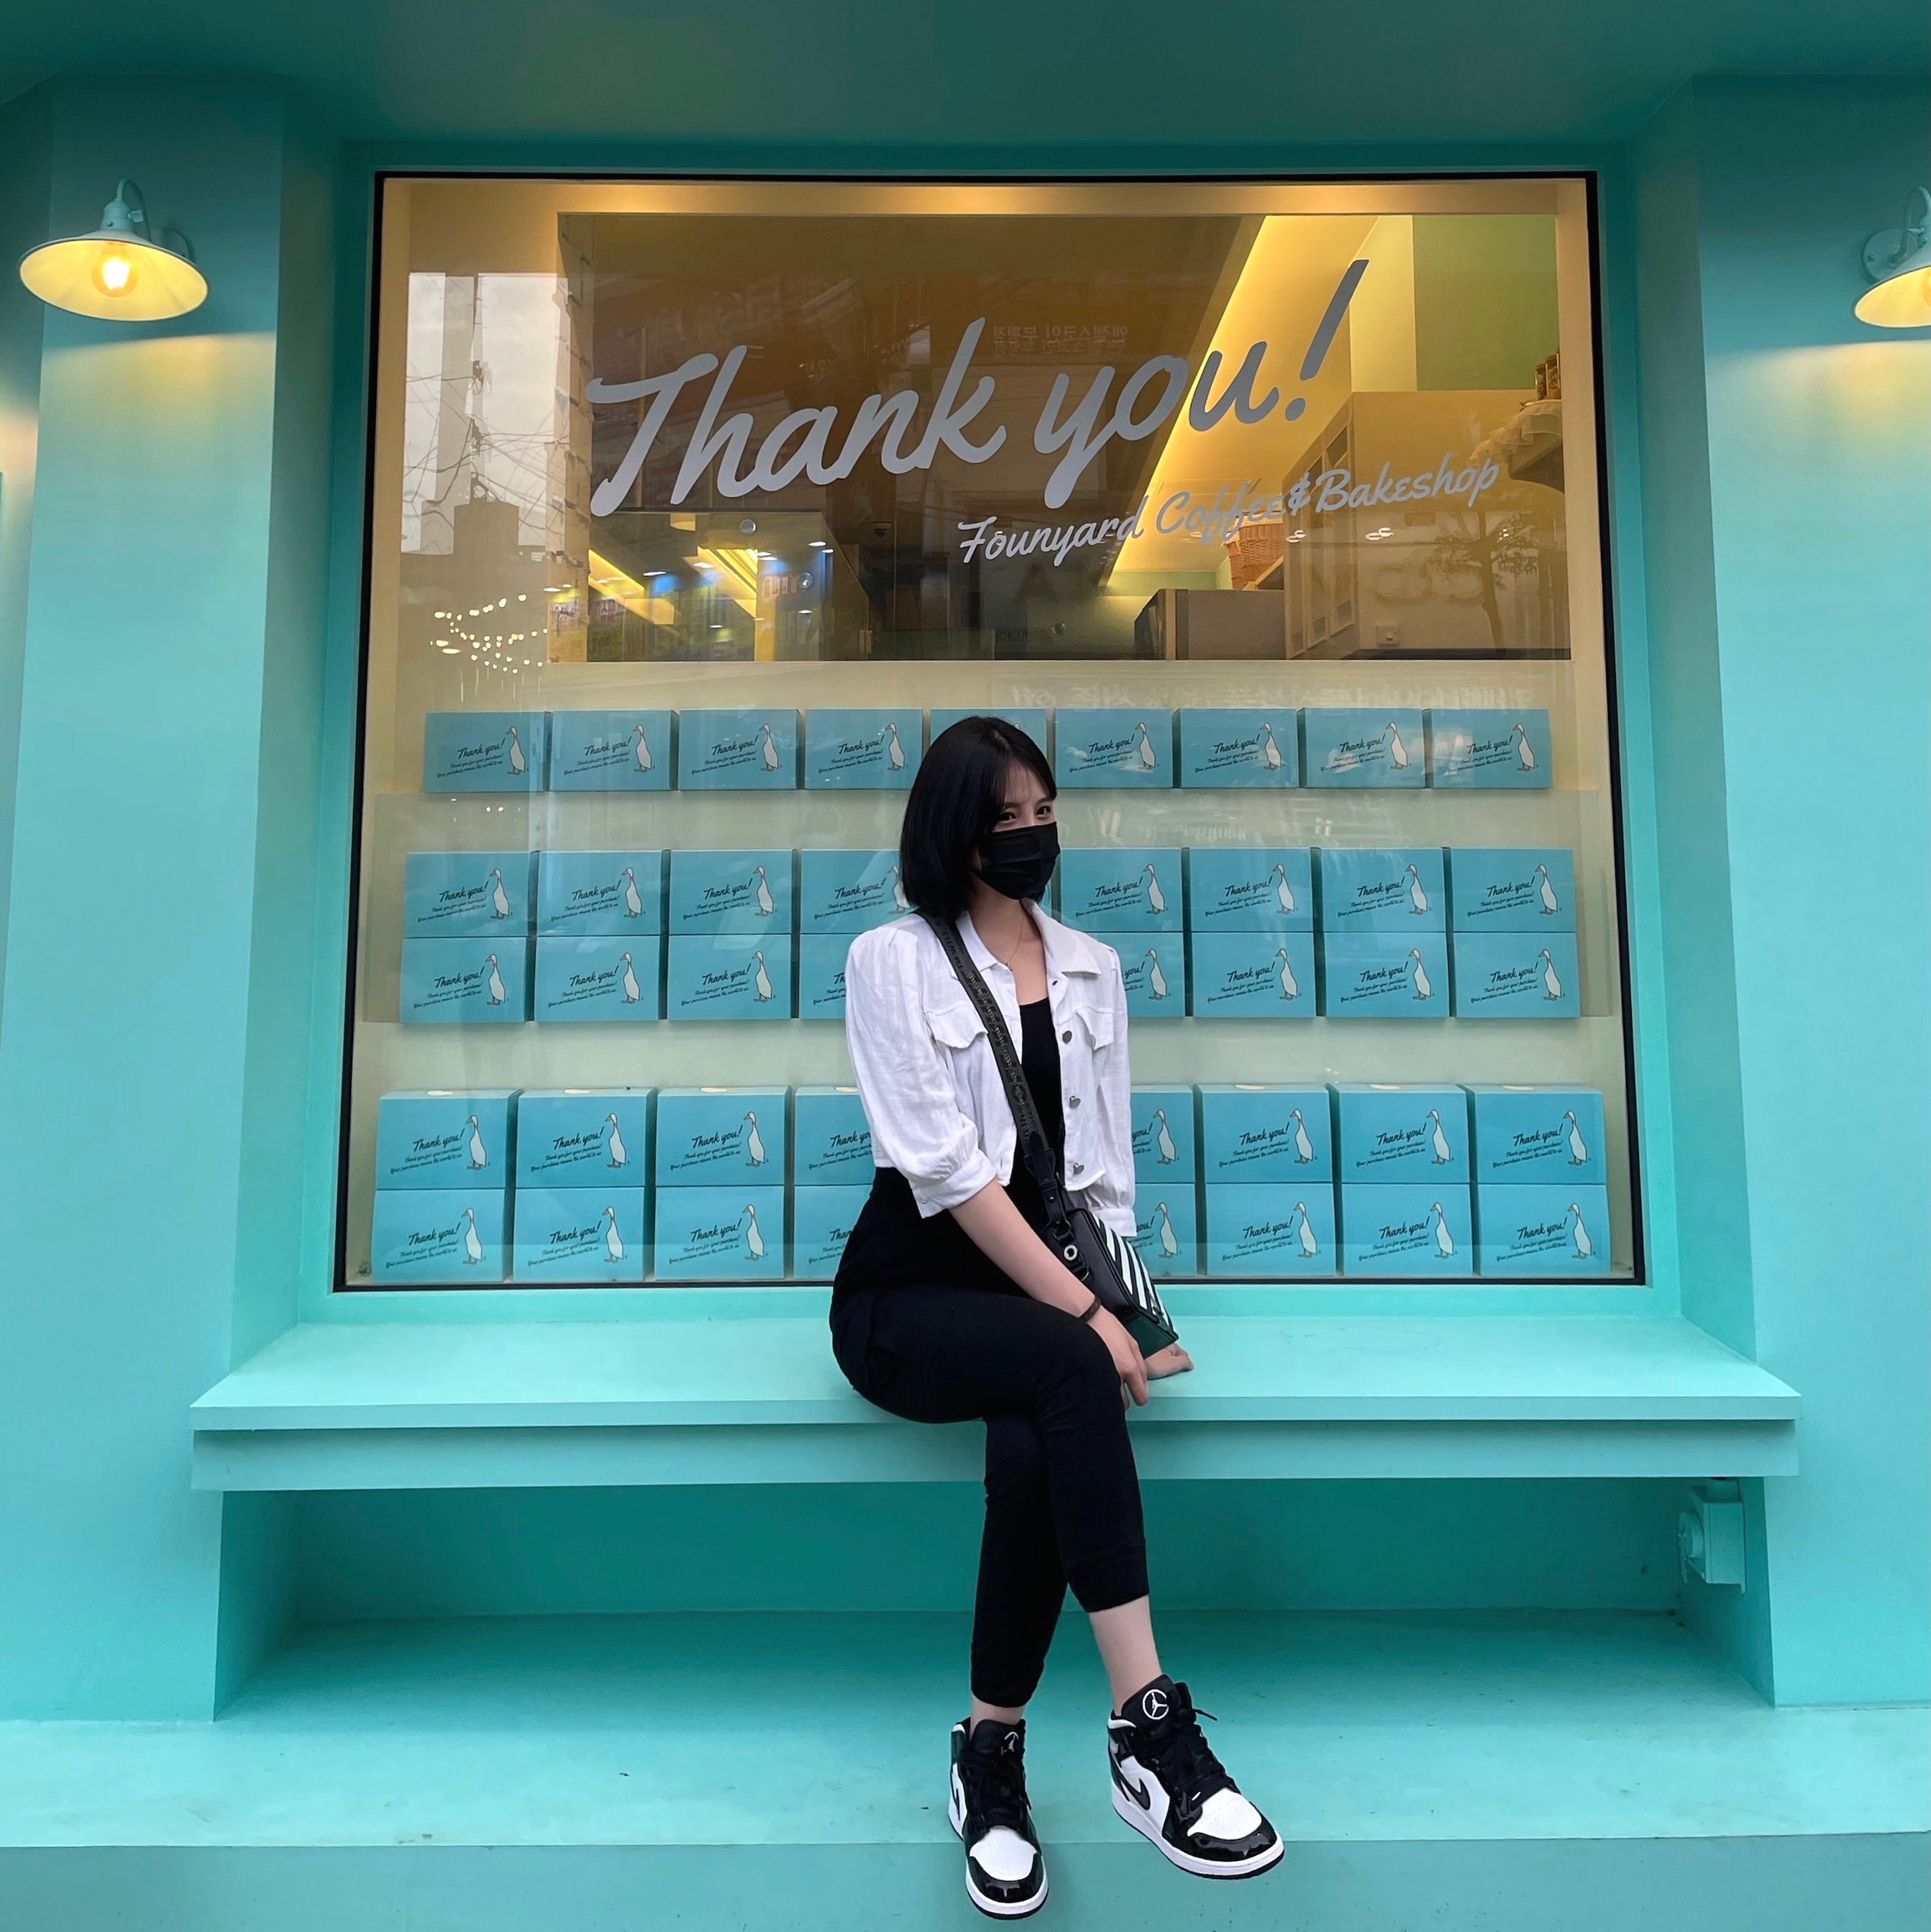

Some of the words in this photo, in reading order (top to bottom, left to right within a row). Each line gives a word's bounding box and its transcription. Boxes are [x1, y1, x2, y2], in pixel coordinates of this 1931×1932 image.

[585, 317, 1006, 516] Thank
[1033, 259, 1369, 509] you!
[957, 494, 1149, 567] Founyard
[457, 744, 483, 759] Thank
[485, 738, 505, 756] you!
[584, 742, 610, 756] Thank
[612, 735, 631, 753] you!
[711, 741, 737, 755] Thank
[739, 734, 758, 752] you!
[838, 740, 863, 755] Thank
[865, 734, 885, 752] you!
[1089, 739, 1114, 754] Thank
[1115, 733, 1135, 751] you!
[1214, 739, 1239, 754] Thank
[1241, 734, 1260, 751] you!
[1339, 739, 1365, 752] Thank
[1366, 733, 1386, 750] you!
[1466, 740, 1492, 755] Thank
[1494, 734, 1513, 752] you!
[439, 887, 466, 902] Thank
[467, 880, 488, 899] you!
[572, 885, 598, 901] Thank
[601, 879, 621, 898] you!
[704, 884, 730, 899] Thank
[732, 878, 752, 896] you!
[834, 884, 862, 899] Thank
[863, 878, 884, 896] you!
[1095, 882, 1121, 897] Thank
[1123, 876, 1143, 894] you!
[1225, 881, 1251, 896] Thank
[1252, 875, 1273, 893] you!
[1357, 882, 1384, 897] Thank
[1385, 876, 1405, 894] you!
[1487, 882, 1513, 897] Thank
[1515, 875, 1535, 894] you!
[434, 972, 462, 988] Thank
[463, 966, 484, 985] you!
[570, 971, 596, 987] Thank
[598, 965, 618, 983] you!
[702, 970, 729, 985] Thank
[730, 963, 751, 982] you!
[1125, 962, 1145, 979] you!
[1227, 967, 1254, 983] Thank
[1255, 961, 1275, 980] you!
[1360, 967, 1387, 982] Thank
[1388, 960, 1409, 980] you!
[1490, 967, 1517, 983] Thank
[1518, 961, 1539, 980] you!
[413, 1135, 441, 1152] Thank
[443, 1128, 465, 1148] you!
[553, 1133, 580, 1149] Thank
[583, 1126, 604, 1147] you!
[692, 1131, 719, 1148] Thank
[721, 1124, 743, 1145] you!
[830, 1131, 858, 1148] Thank
[859, 1131, 872, 1144] yo
[1132, 1122, 1153, 1141] you!
[1239, 1129, 1267, 1145] Thank
[1269, 1122, 1290, 1142] you!
[1377, 1129, 1404, 1145] Thank
[1406, 1122, 1427, 1142] you!
[1513, 1130, 1540, 1146] Thank
[1542, 1123, 1563, 1143] you!
[408, 1229, 437, 1246] Thank
[439, 1221, 460, 1242] you!
[550, 1227, 578, 1244] Thank
[580, 1220, 601, 1241] you!
[690, 1225, 718, 1241] Thank
[720, 1218, 741, 1239] you!
[830, 1229, 852, 1242] Than
[1243, 1222, 1271, 1239] Thank
[1272, 1215, 1294, 1236] you!
[1379, 1222, 1407, 1239] Thank
[1409, 1216, 1430, 1236] you!
[1517, 1223, 1545, 1239] Thank
[1546, 1216, 1568, 1236] you!
